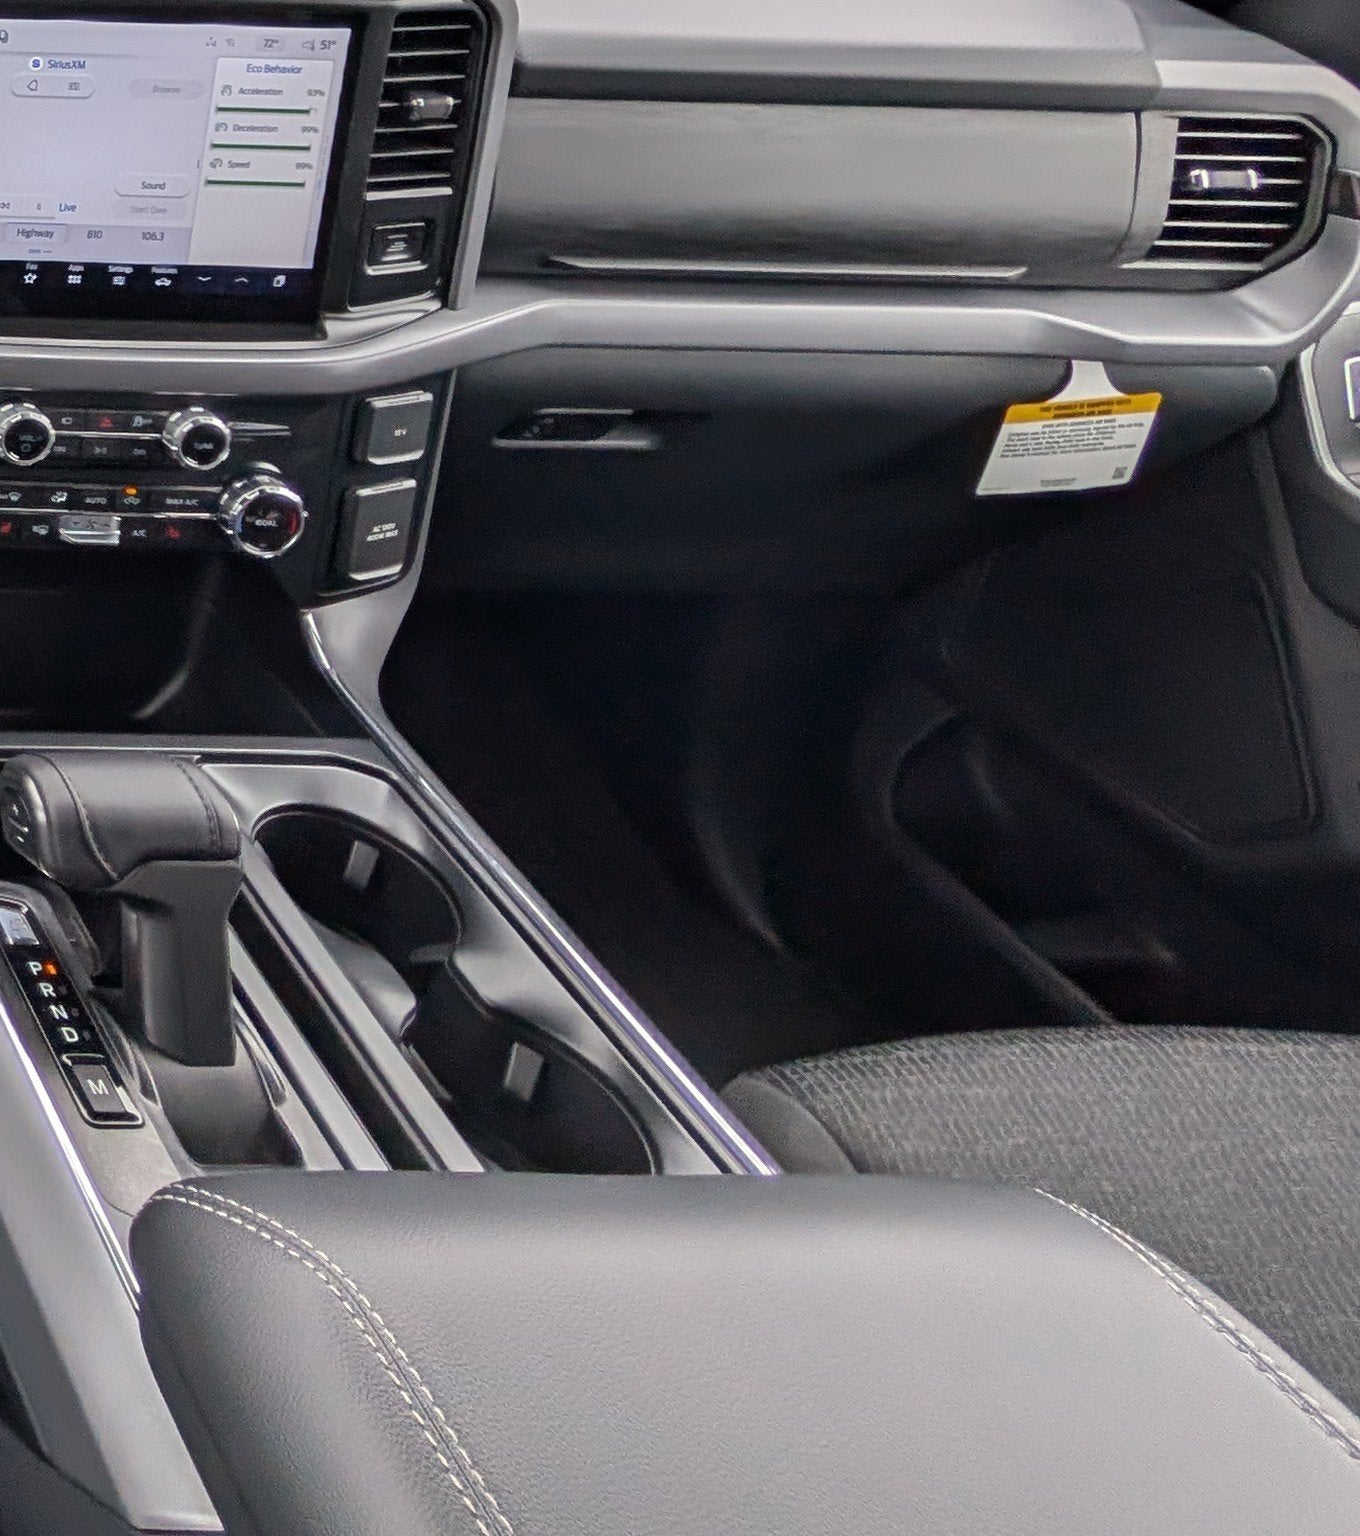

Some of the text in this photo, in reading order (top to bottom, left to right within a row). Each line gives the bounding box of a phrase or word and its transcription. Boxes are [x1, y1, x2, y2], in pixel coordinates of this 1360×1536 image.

[47, 59, 86, 70] SiriusXM
[246, 63, 303, 75] Eco Behavior
[237, 87, 284, 96] Acceleration
[232, 124, 279, 133] Deceleration
[227, 160, 251, 171] Speed
[140, 181, 167, 190] Sound
[58, 202, 77, 213] Live
[16, 227, 55, 240] Highway
[141, 231, 165, 241] 106.3
[85, 496, 108, 505] AUTO
[27, 961, 43, 976] P
[38, 982, 56, 998] R
[49, 1004, 69, 1020] N
[61, 1026, 79, 1043] D
[86, 1078, 109, 1095] M
